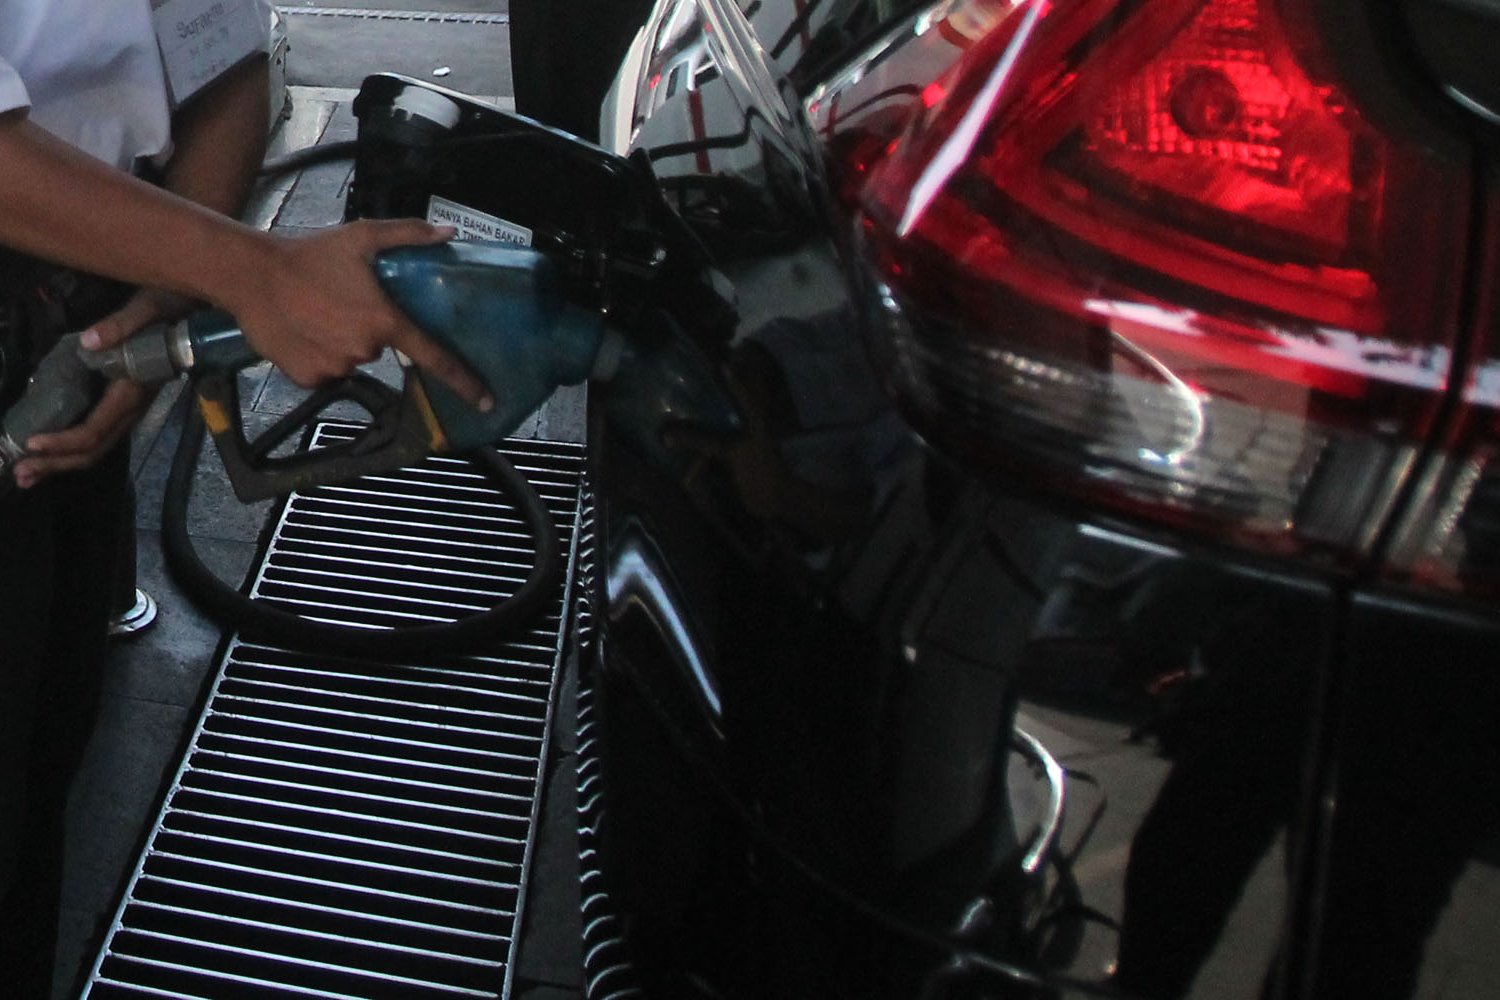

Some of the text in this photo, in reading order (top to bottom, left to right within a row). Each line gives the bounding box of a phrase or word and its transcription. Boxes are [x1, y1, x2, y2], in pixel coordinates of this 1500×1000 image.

[434, 207, 462, 225] HANYA
[463, 217, 493, 236] BAHAN
[495, 228, 526, 245] BAKAR
